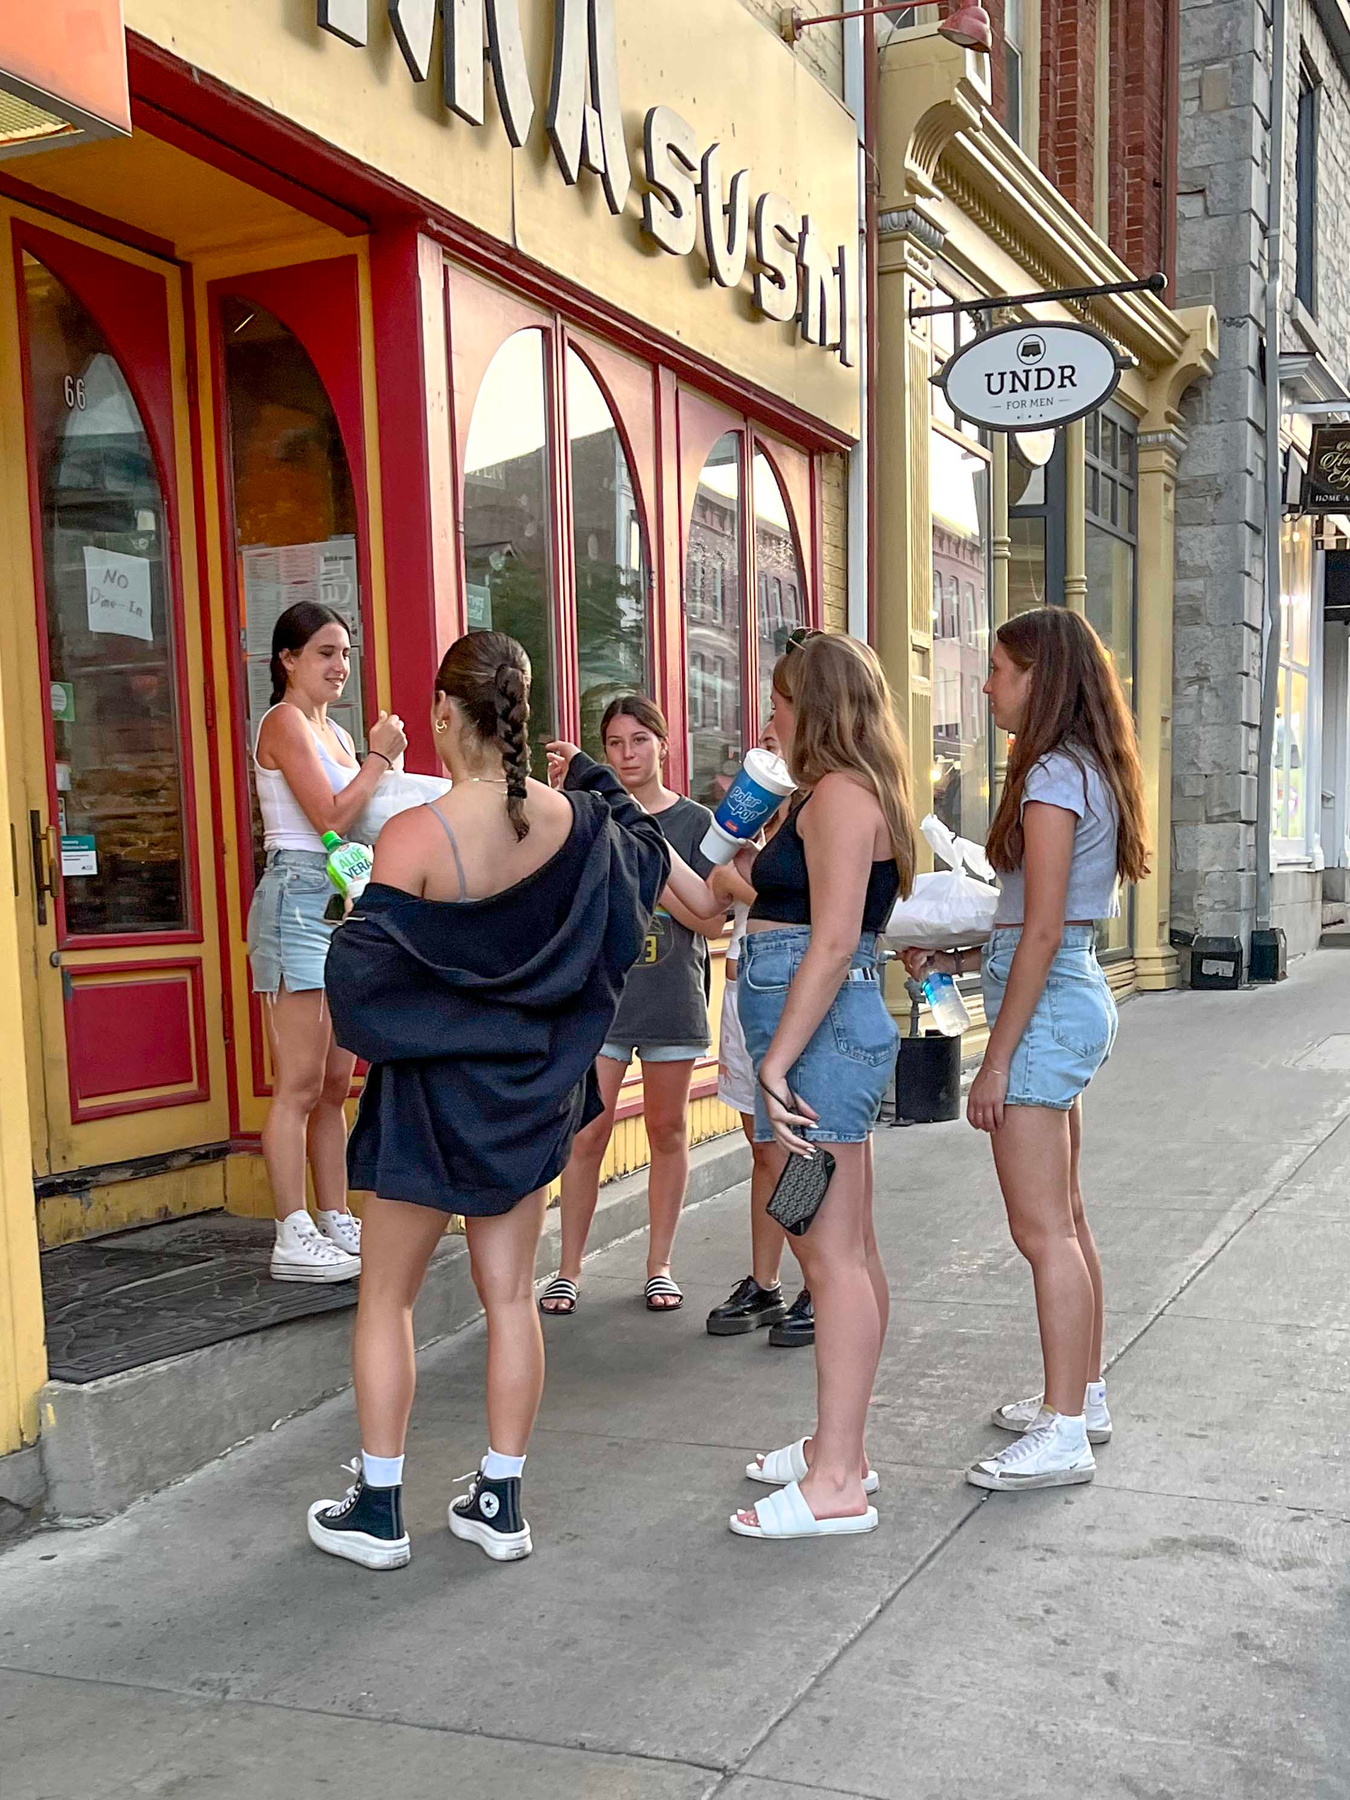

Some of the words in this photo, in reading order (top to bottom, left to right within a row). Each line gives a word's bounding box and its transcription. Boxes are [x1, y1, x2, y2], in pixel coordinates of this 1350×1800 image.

[642, 105, 854, 368] SUSHI
[985, 364, 1078, 396] UNDR
[64, 375, 86, 410] 66
[1006, 399, 1027, 410] FOR
[1029, 397, 1055, 408] MEN
[1315, 494, 1341, 502] HOME
[103, 568, 129, 589] NO
[729, 786, 762, 809] Polar
[731, 804, 760, 824] Pop
[339, 848, 366, 870] ALOE
[341, 859, 373, 880] VERA
